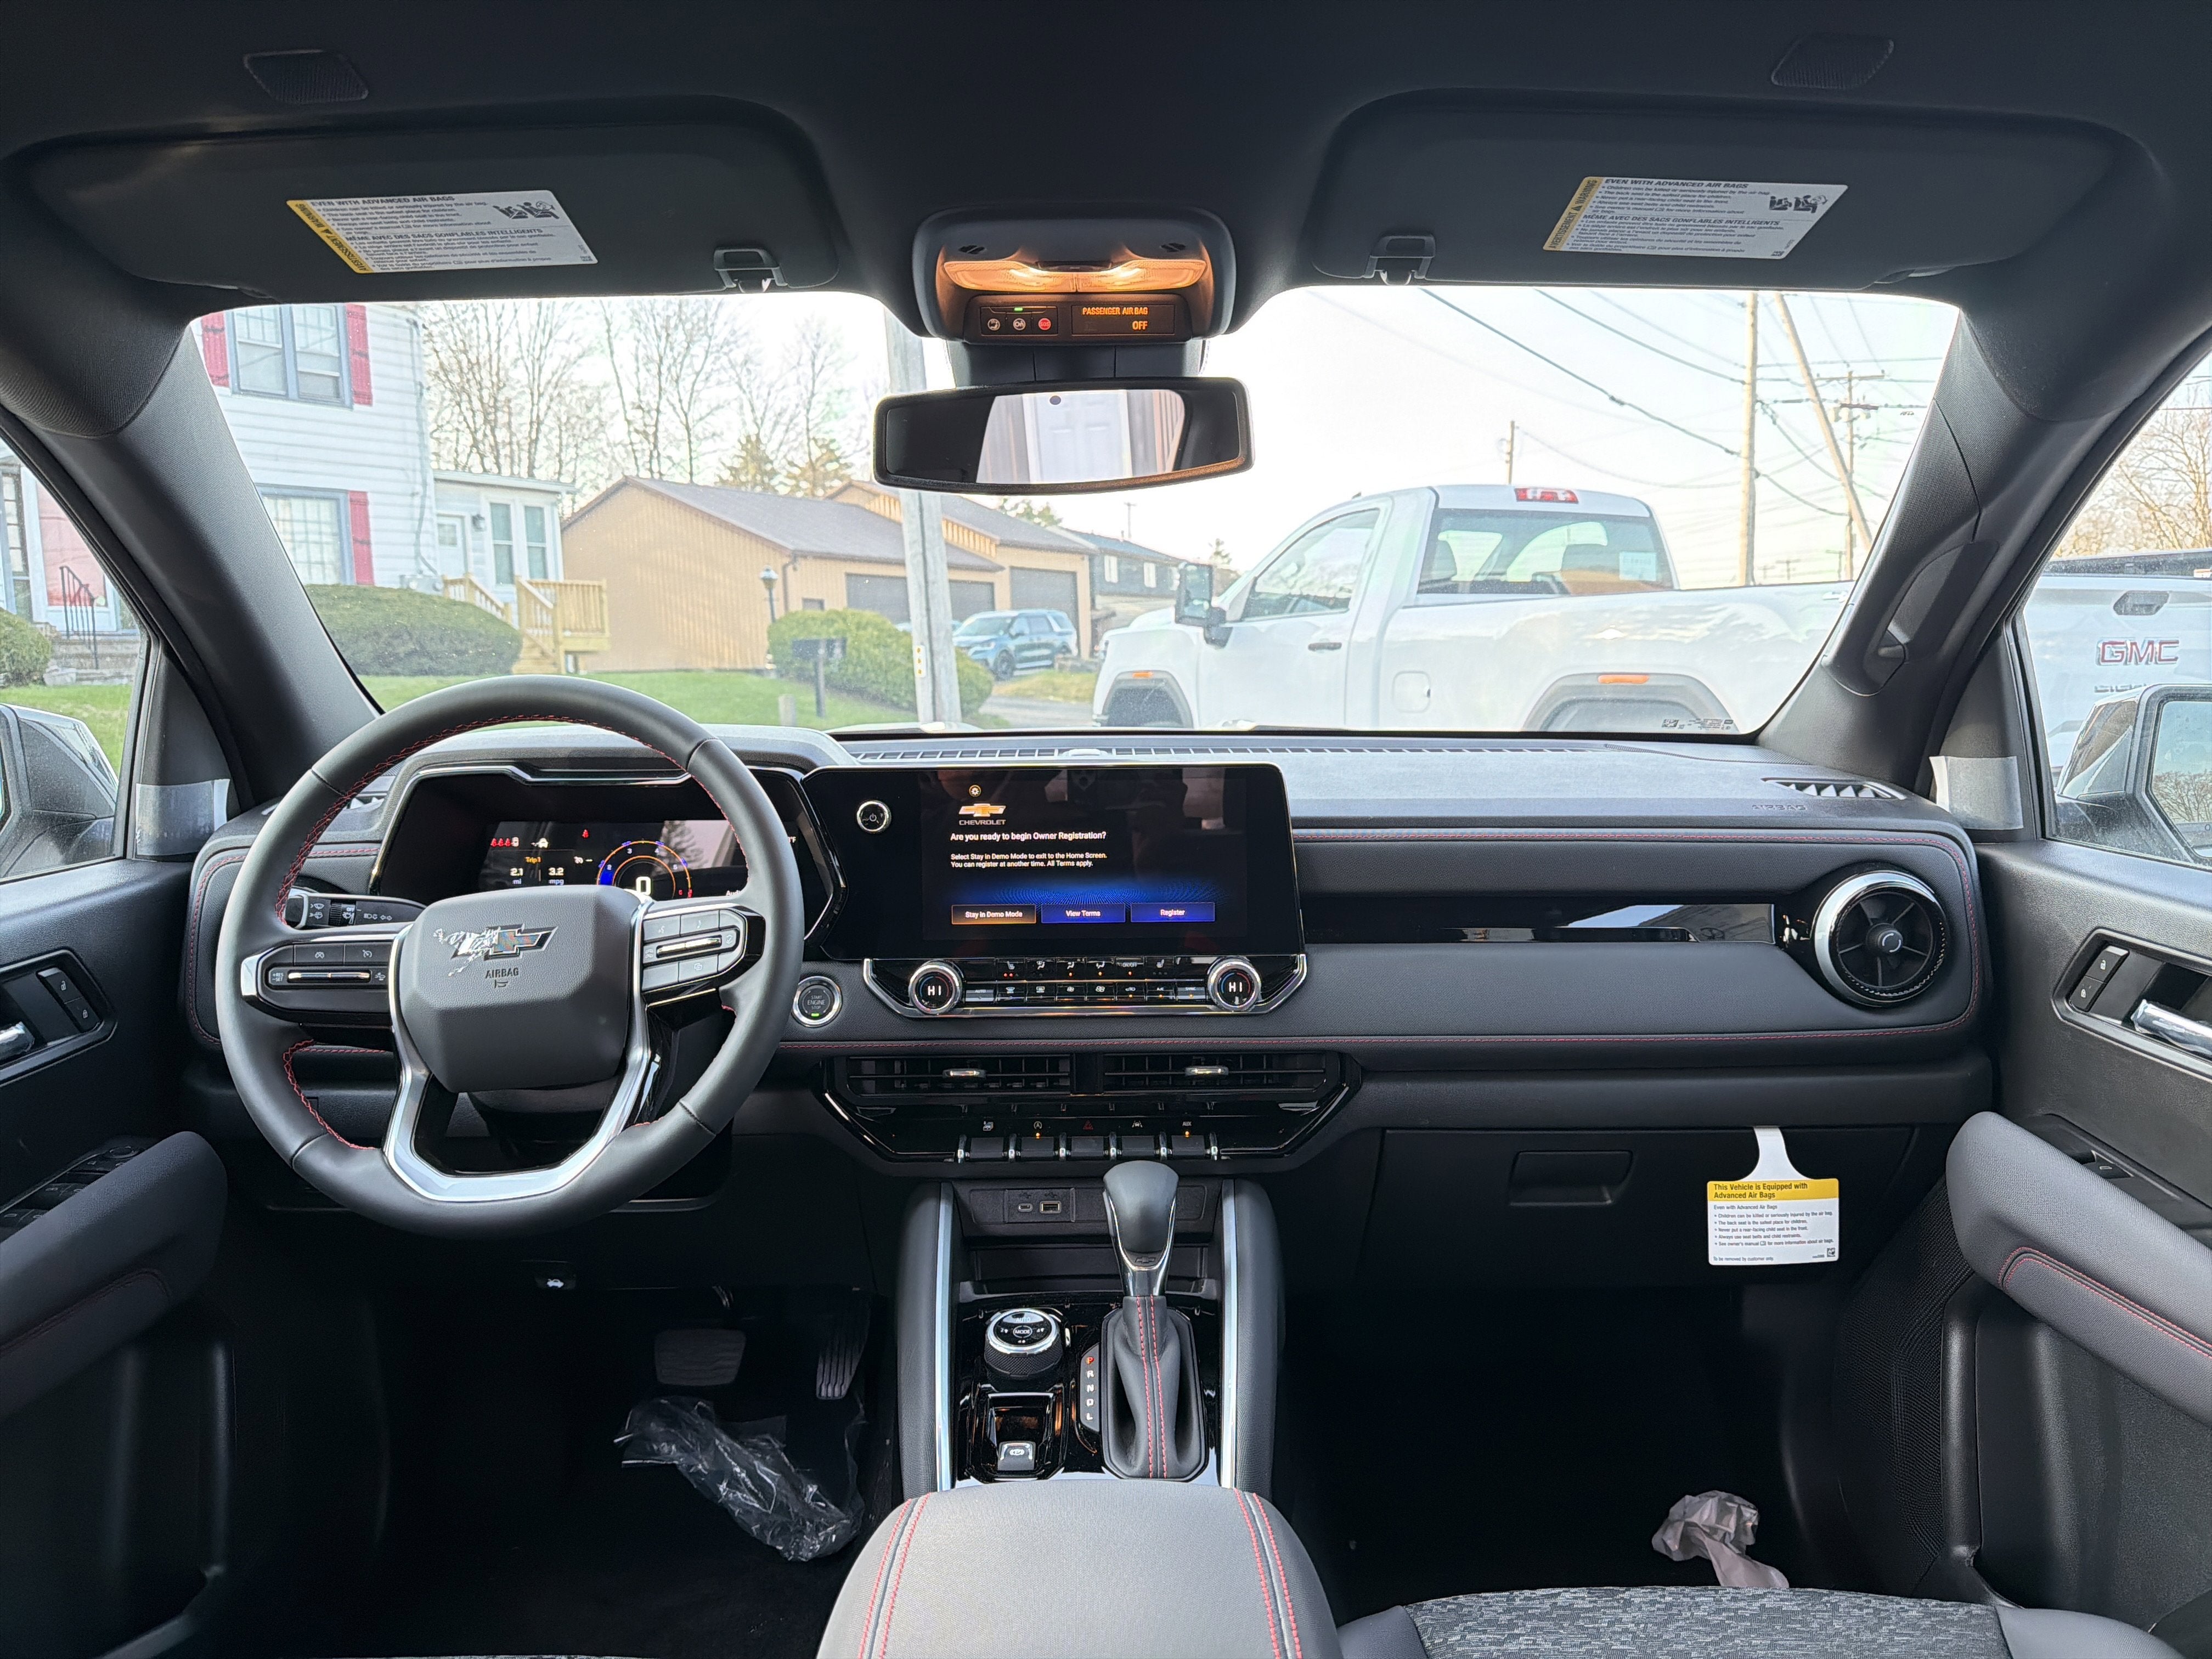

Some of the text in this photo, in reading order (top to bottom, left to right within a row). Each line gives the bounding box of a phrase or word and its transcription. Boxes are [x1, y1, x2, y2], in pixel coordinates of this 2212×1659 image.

[1132, 320, 1148, 330] OFF
[2098, 639, 2180, 664] GMC
[980, 832, 1001, 842] ready
[1011, 832, 1031, 841] begin
[1059, 831, 1106, 840] Registration?
[510, 867, 523, 876] 2.1
[548, 867, 564, 876] 3.2
[636, 876, 651, 895] 0
[966, 911, 979, 919] Stay
[1160, 909, 1186, 917] Register
[485, 967, 519, 979] AIRBAG
[1087, 1370, 1094, 1378] R
[1087, 1384, 1094, 1392] N
